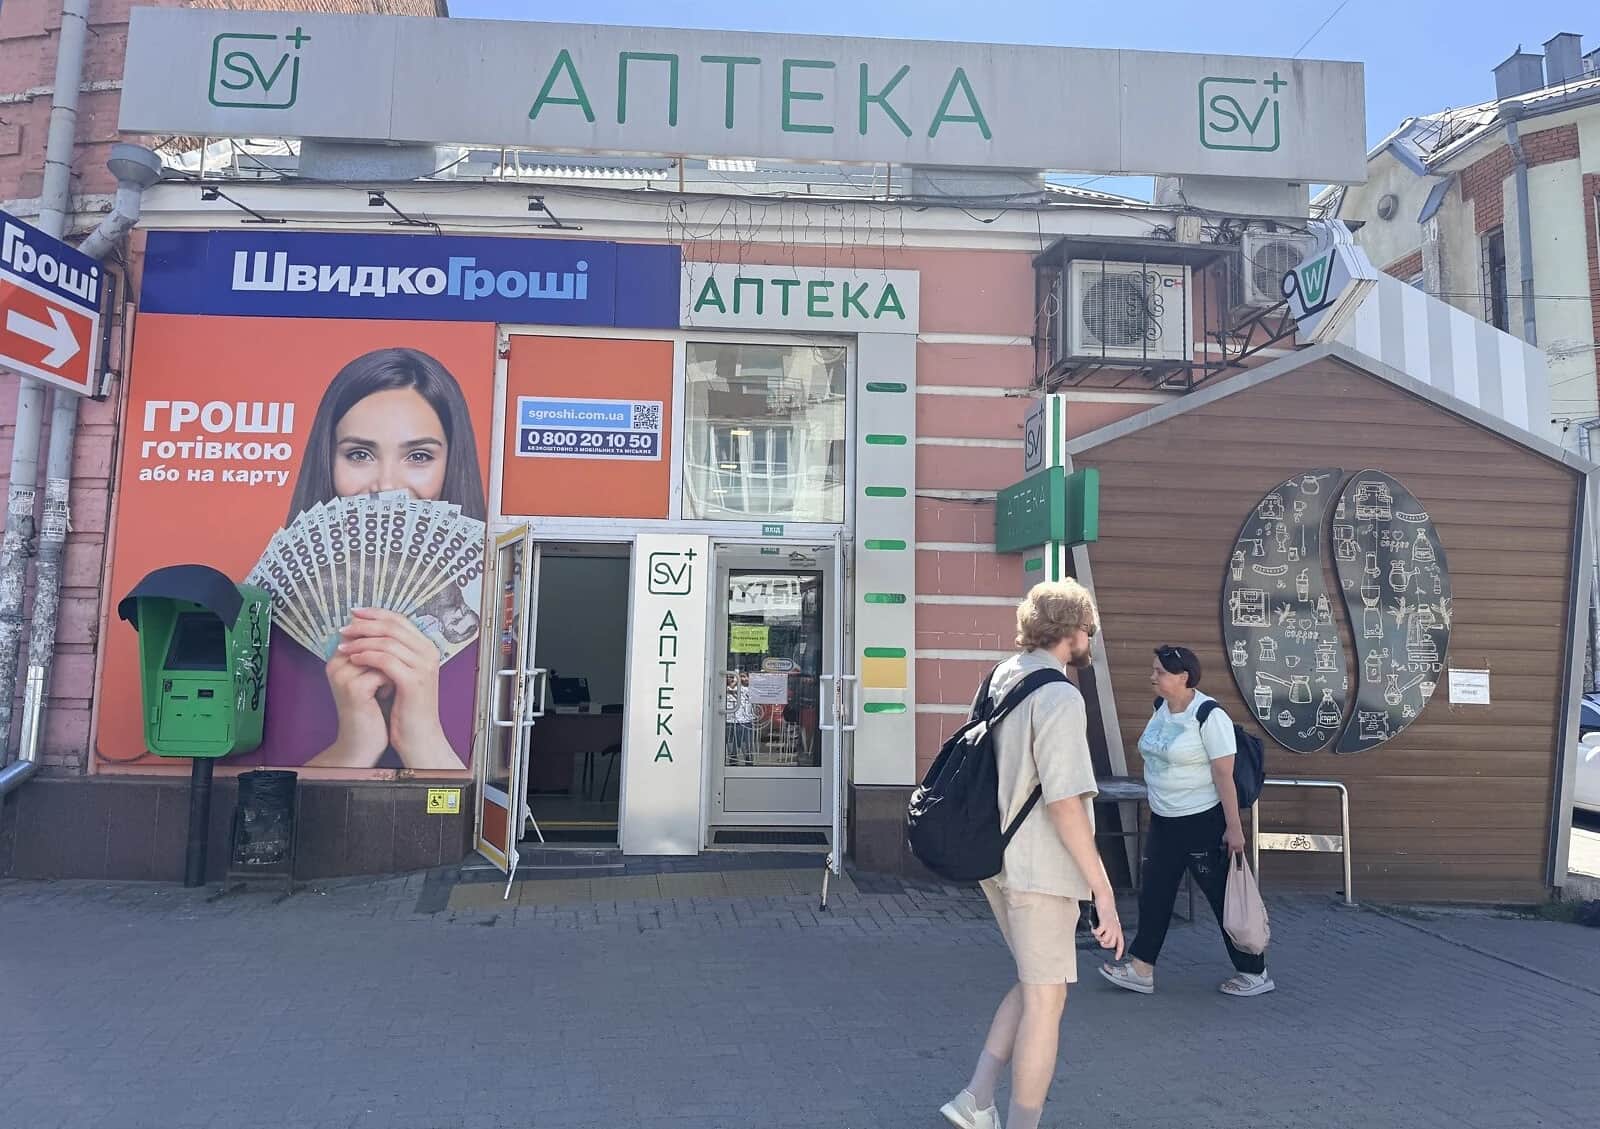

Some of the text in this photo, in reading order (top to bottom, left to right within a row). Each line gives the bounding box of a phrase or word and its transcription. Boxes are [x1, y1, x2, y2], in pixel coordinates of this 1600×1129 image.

[528, 49, 992, 140] АПТЕКА
[2, 221, 98, 304] Гроші
[231, 251, 589, 300] ШвидкоГроші
[694, 276, 906, 321] АПТЕКА
[143, 400, 295, 434] ГРОШІ
[528, 409, 625, 421] sgroshi.com.ua
[141, 435, 293, 461] готівкою
[528, 431, 652, 449] 0 800 20 10 50
[138, 465, 290, 487] або на карту
[654, 610, 678, 763] АПТЕКА
